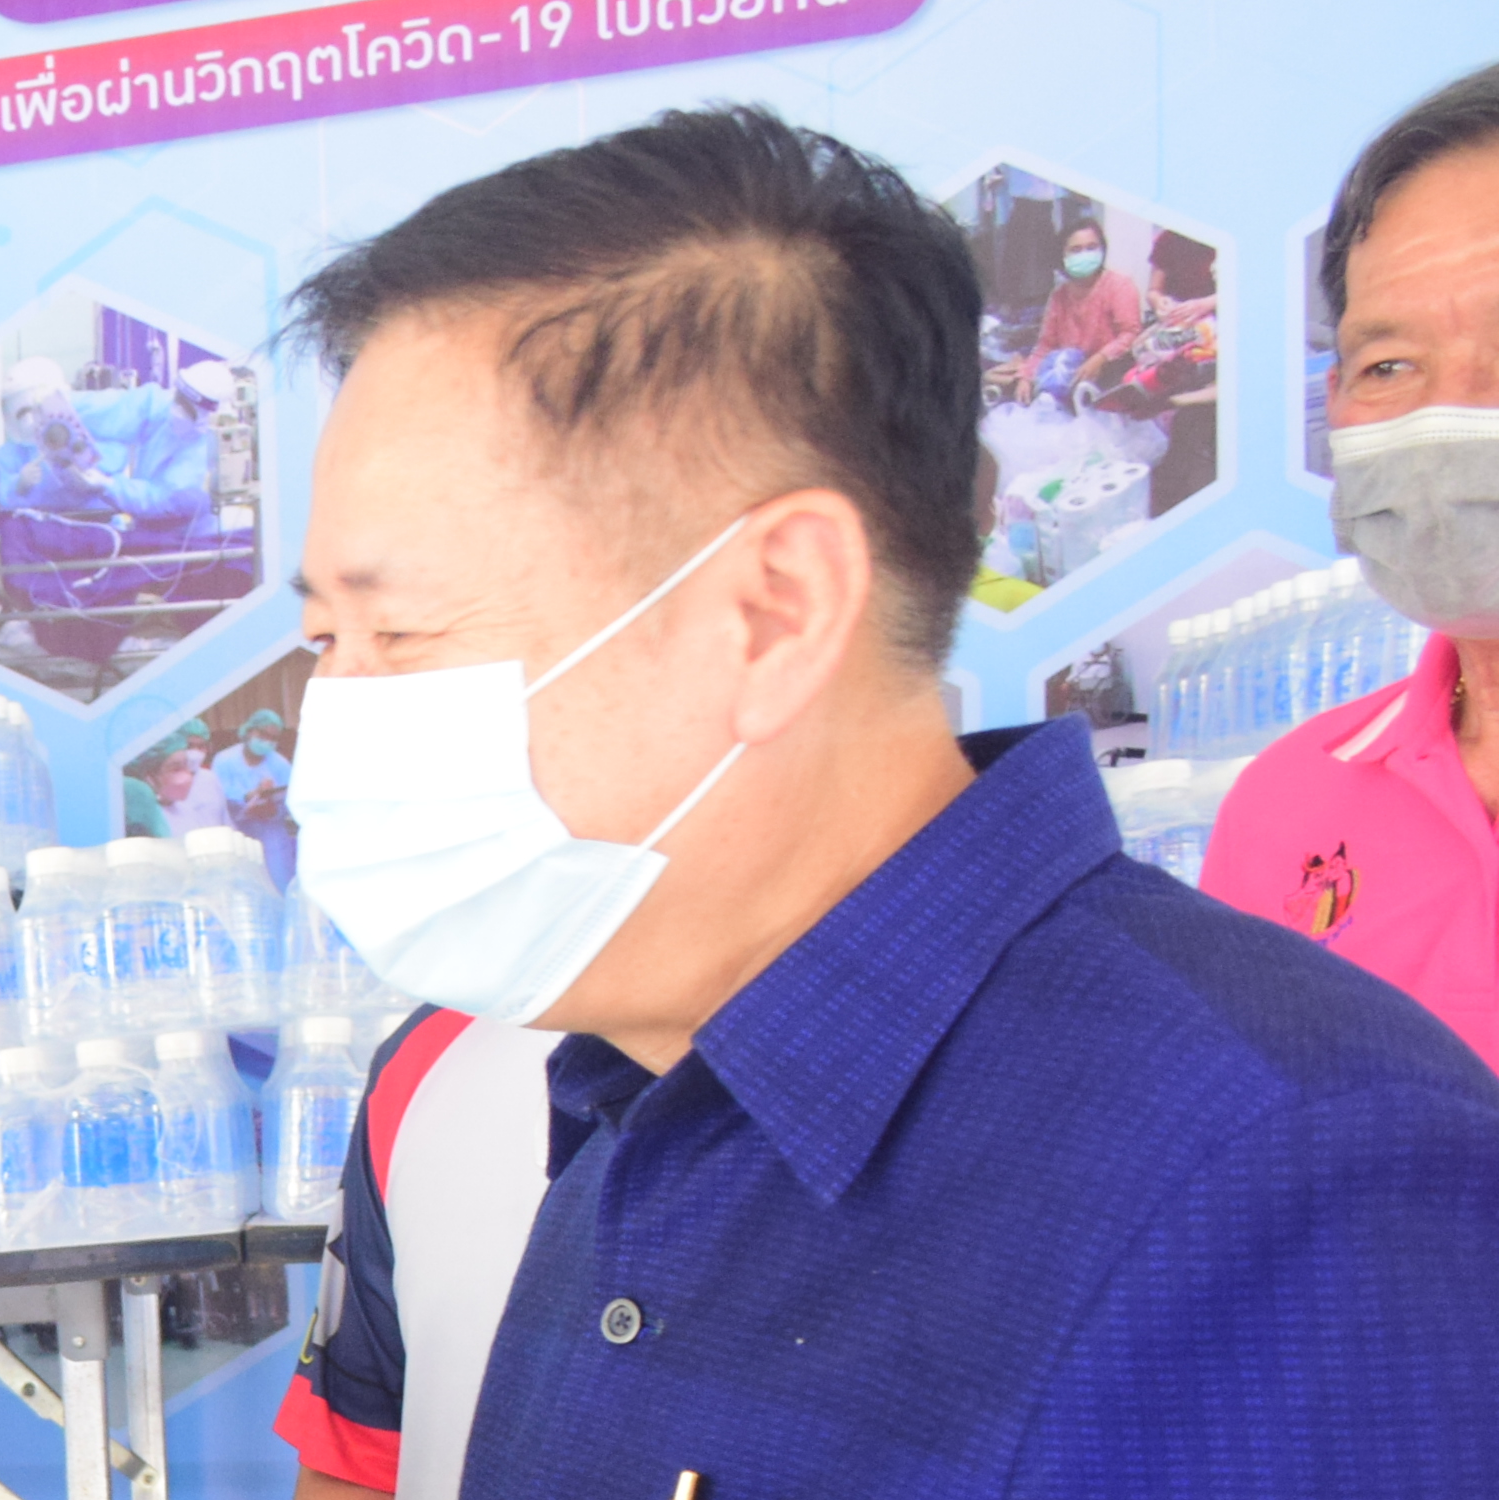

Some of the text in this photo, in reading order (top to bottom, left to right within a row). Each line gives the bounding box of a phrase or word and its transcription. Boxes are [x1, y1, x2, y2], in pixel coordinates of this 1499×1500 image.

[0, 1, 572, 132] เพื่อผ่านวิกฤตโควิด-19
